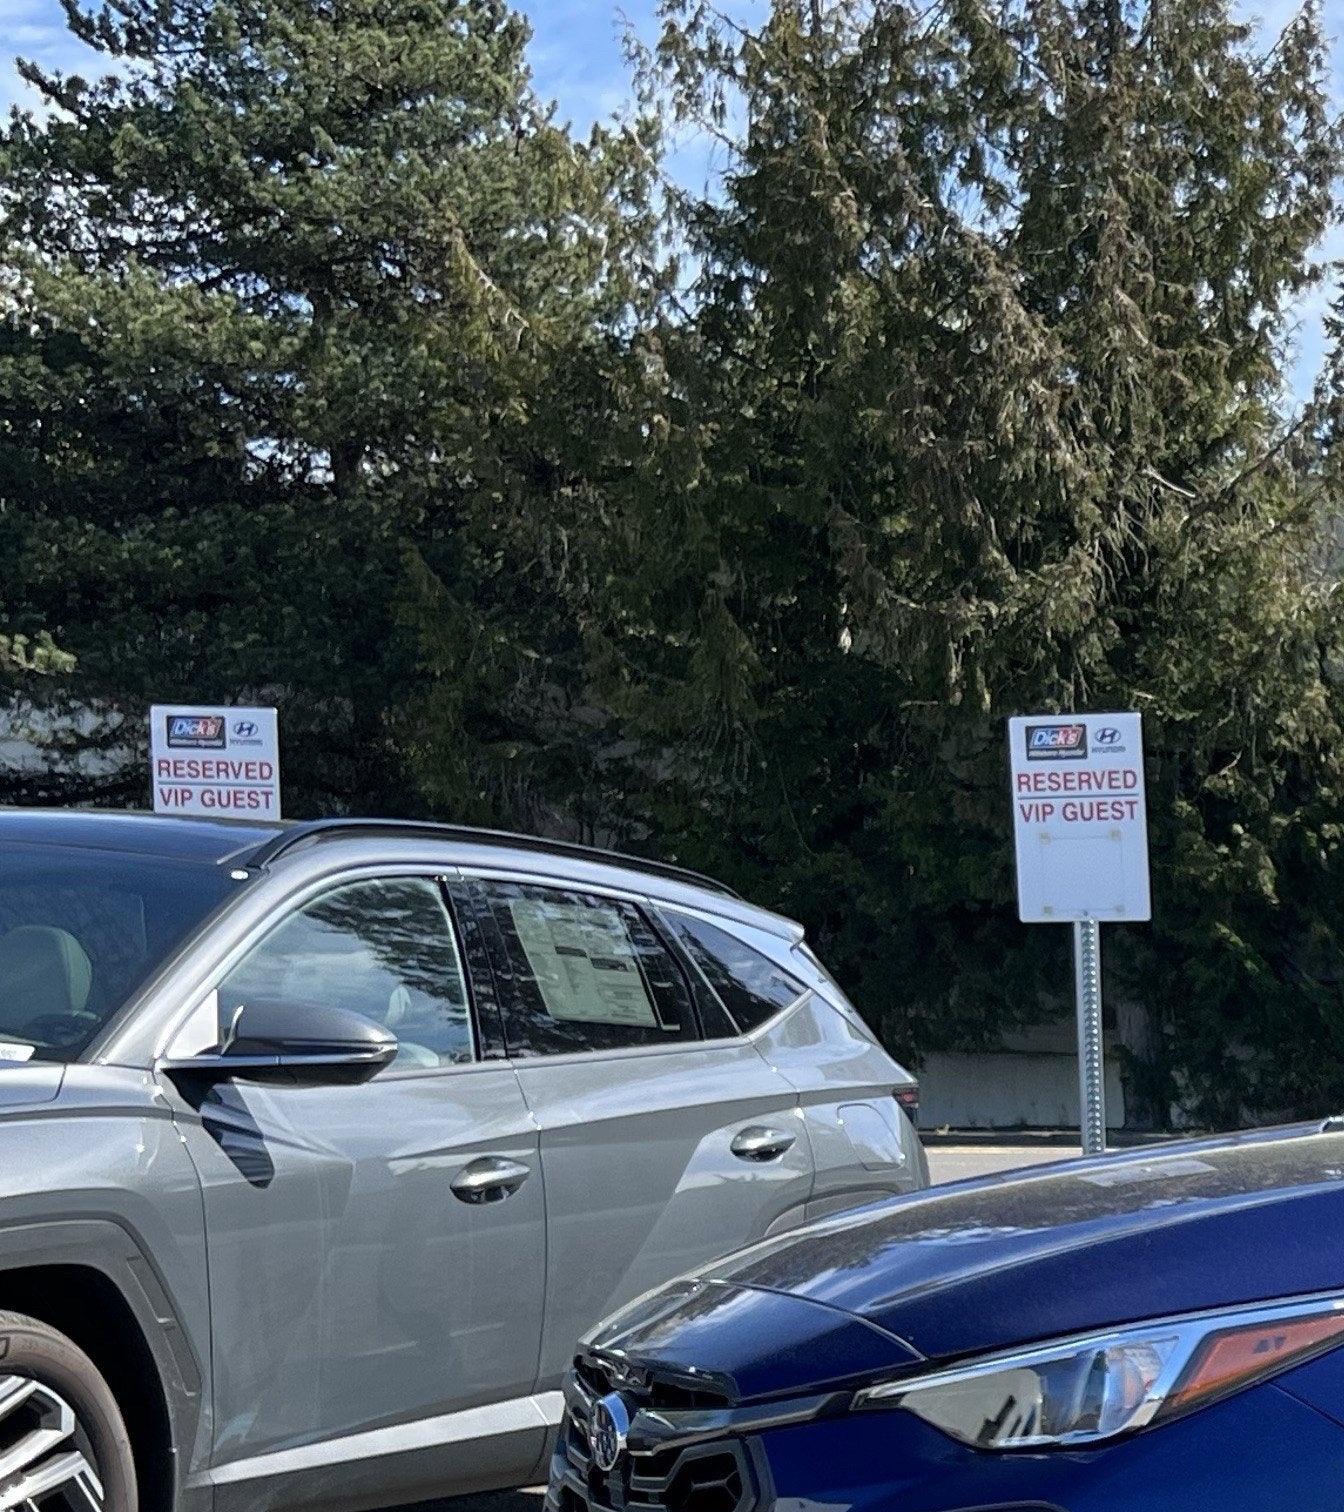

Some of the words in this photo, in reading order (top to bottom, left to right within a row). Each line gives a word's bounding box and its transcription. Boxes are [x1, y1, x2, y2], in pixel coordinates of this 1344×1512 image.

[157, 758, 274, 781] RESERVED
[1017, 769, 1138, 793] RESERVED
[159, 787, 194, 808] VIP
[200, 788, 274, 810] GUEST
[1019, 803, 1055, 823] VIP
[1062, 800, 1139, 822] GUEST
